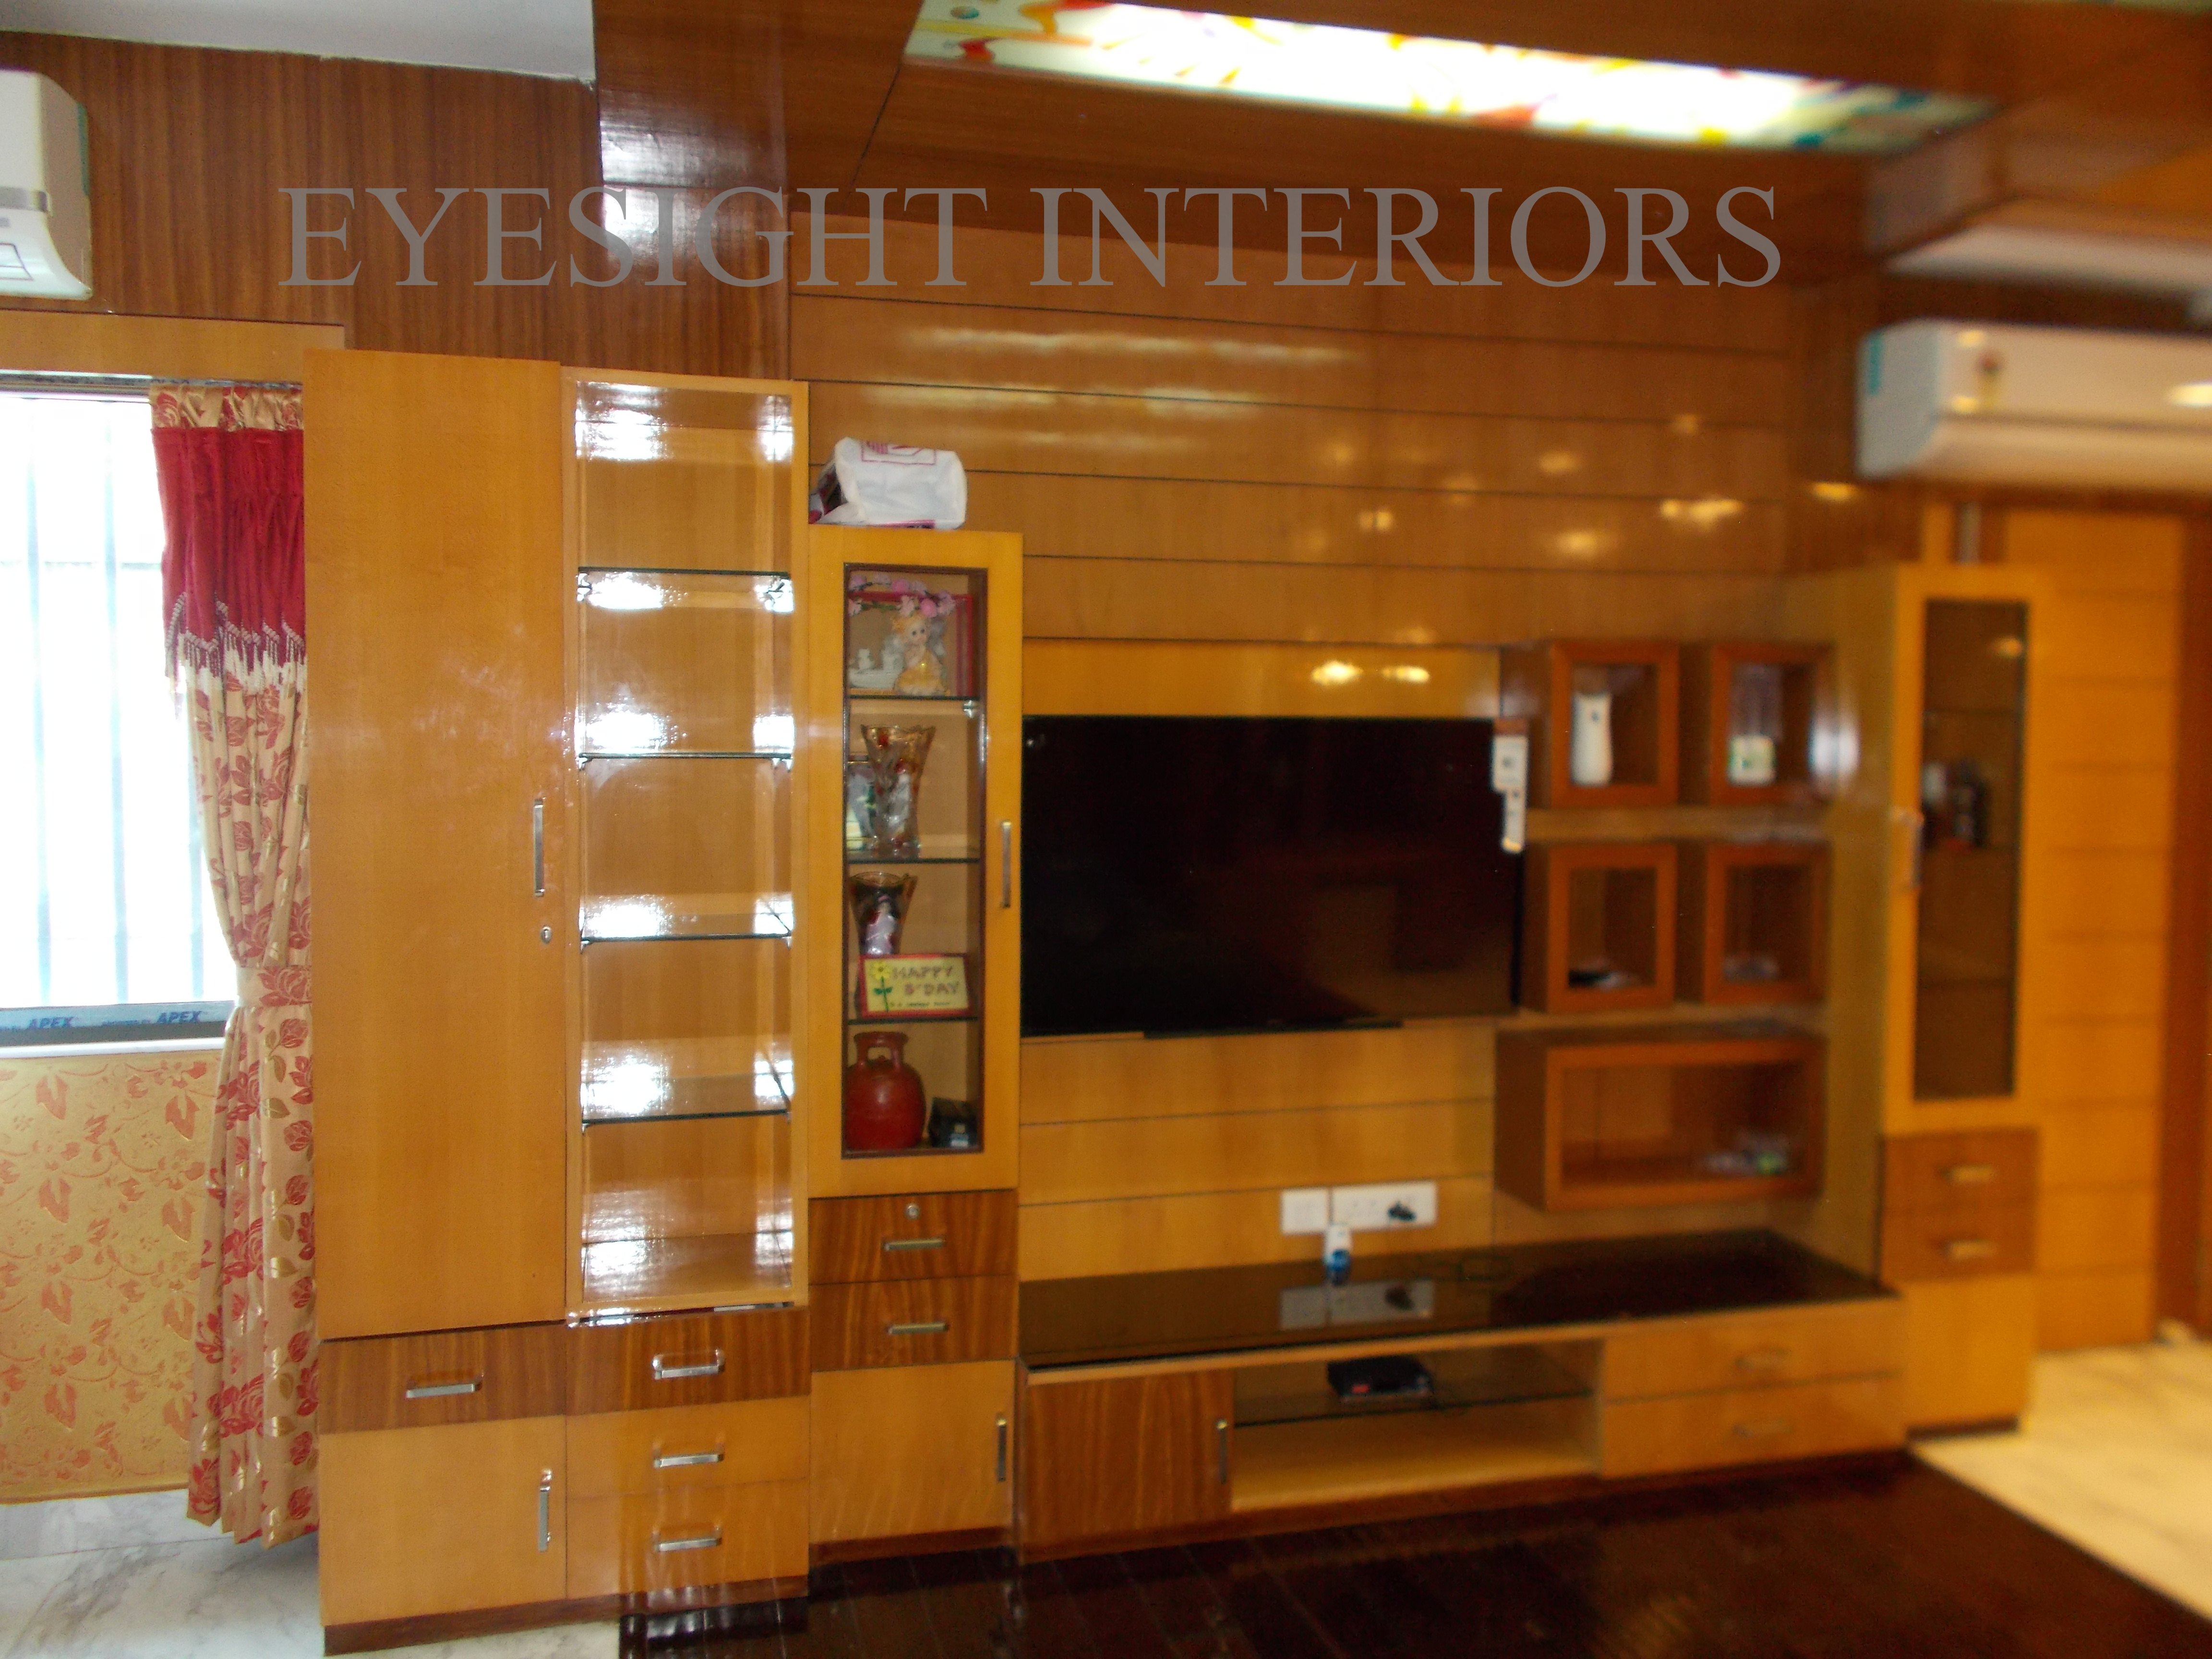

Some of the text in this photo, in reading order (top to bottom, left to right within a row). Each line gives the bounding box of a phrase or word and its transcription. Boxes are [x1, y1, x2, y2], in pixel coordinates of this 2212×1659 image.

[892, 965, 953, 980] HAPPY
[27, 1016, 73, 1029] APEX
[156, 1010, 203, 1023] APEX
